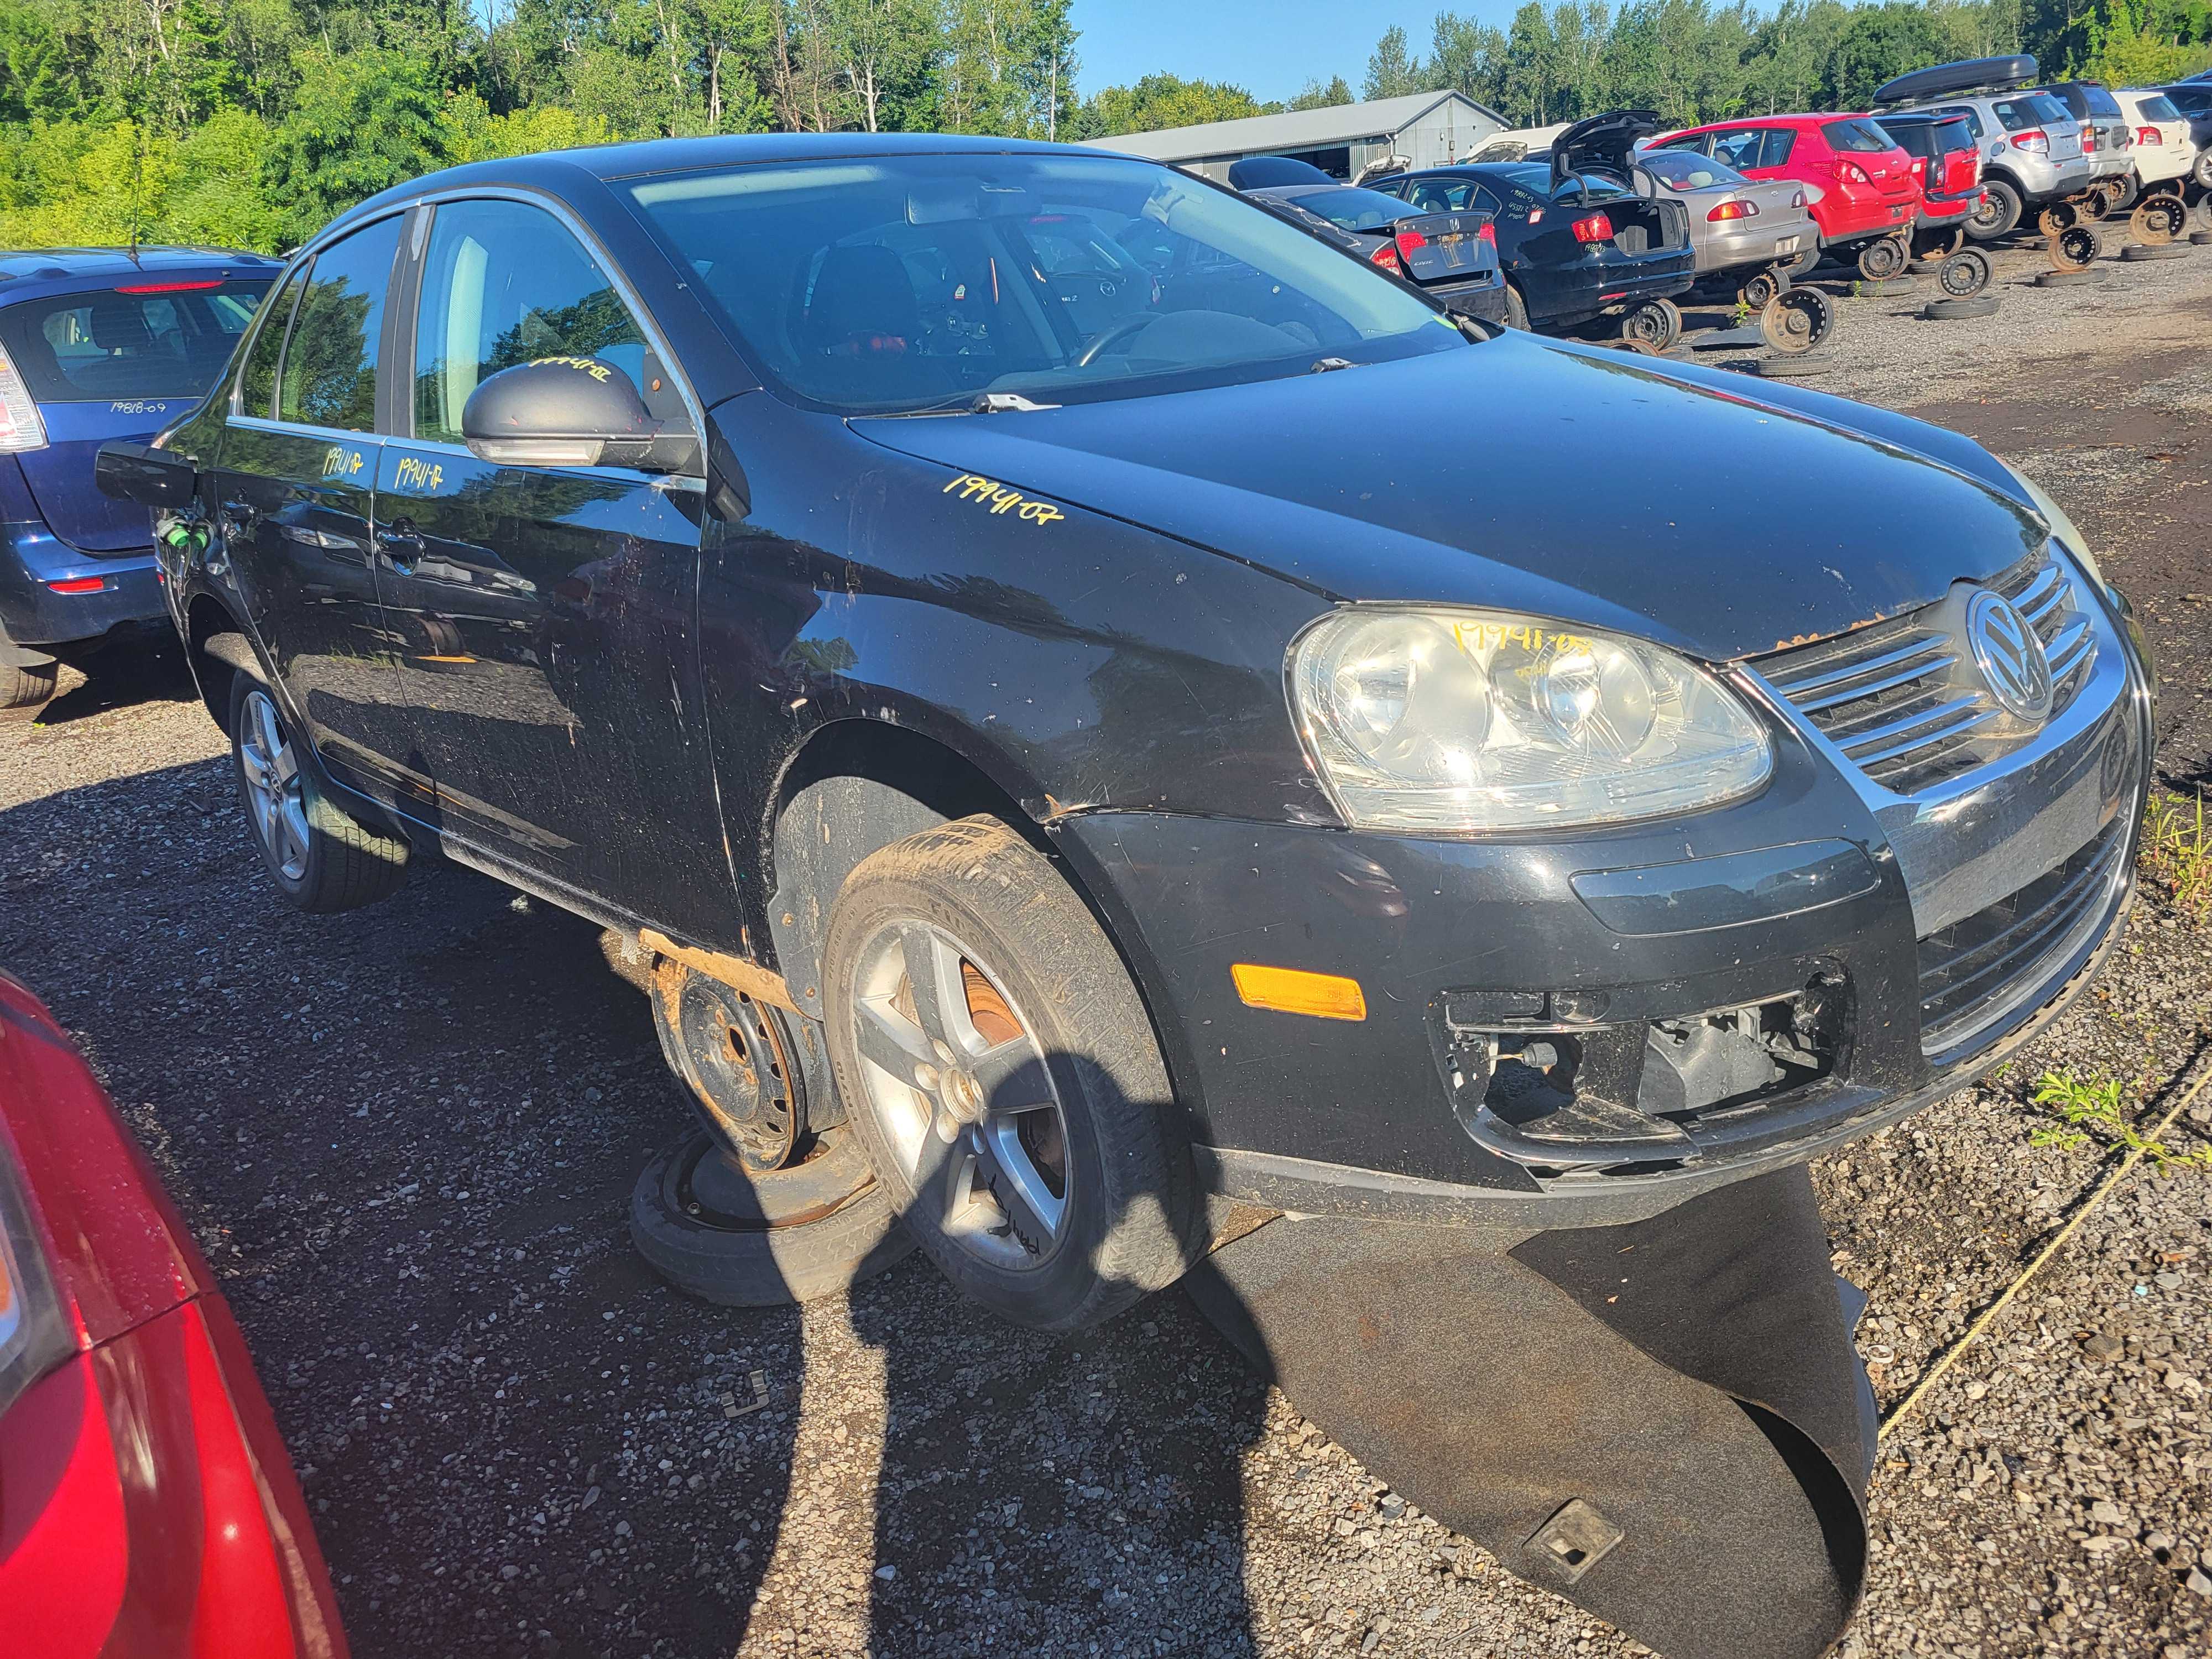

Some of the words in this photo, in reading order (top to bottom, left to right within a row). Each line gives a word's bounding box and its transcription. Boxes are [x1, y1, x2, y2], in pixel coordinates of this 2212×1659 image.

[110, 401, 166, 414] 19818-09
[942, 474, 1065, 526] 19941-07
[835, 1060, 859, 1121] FR710
